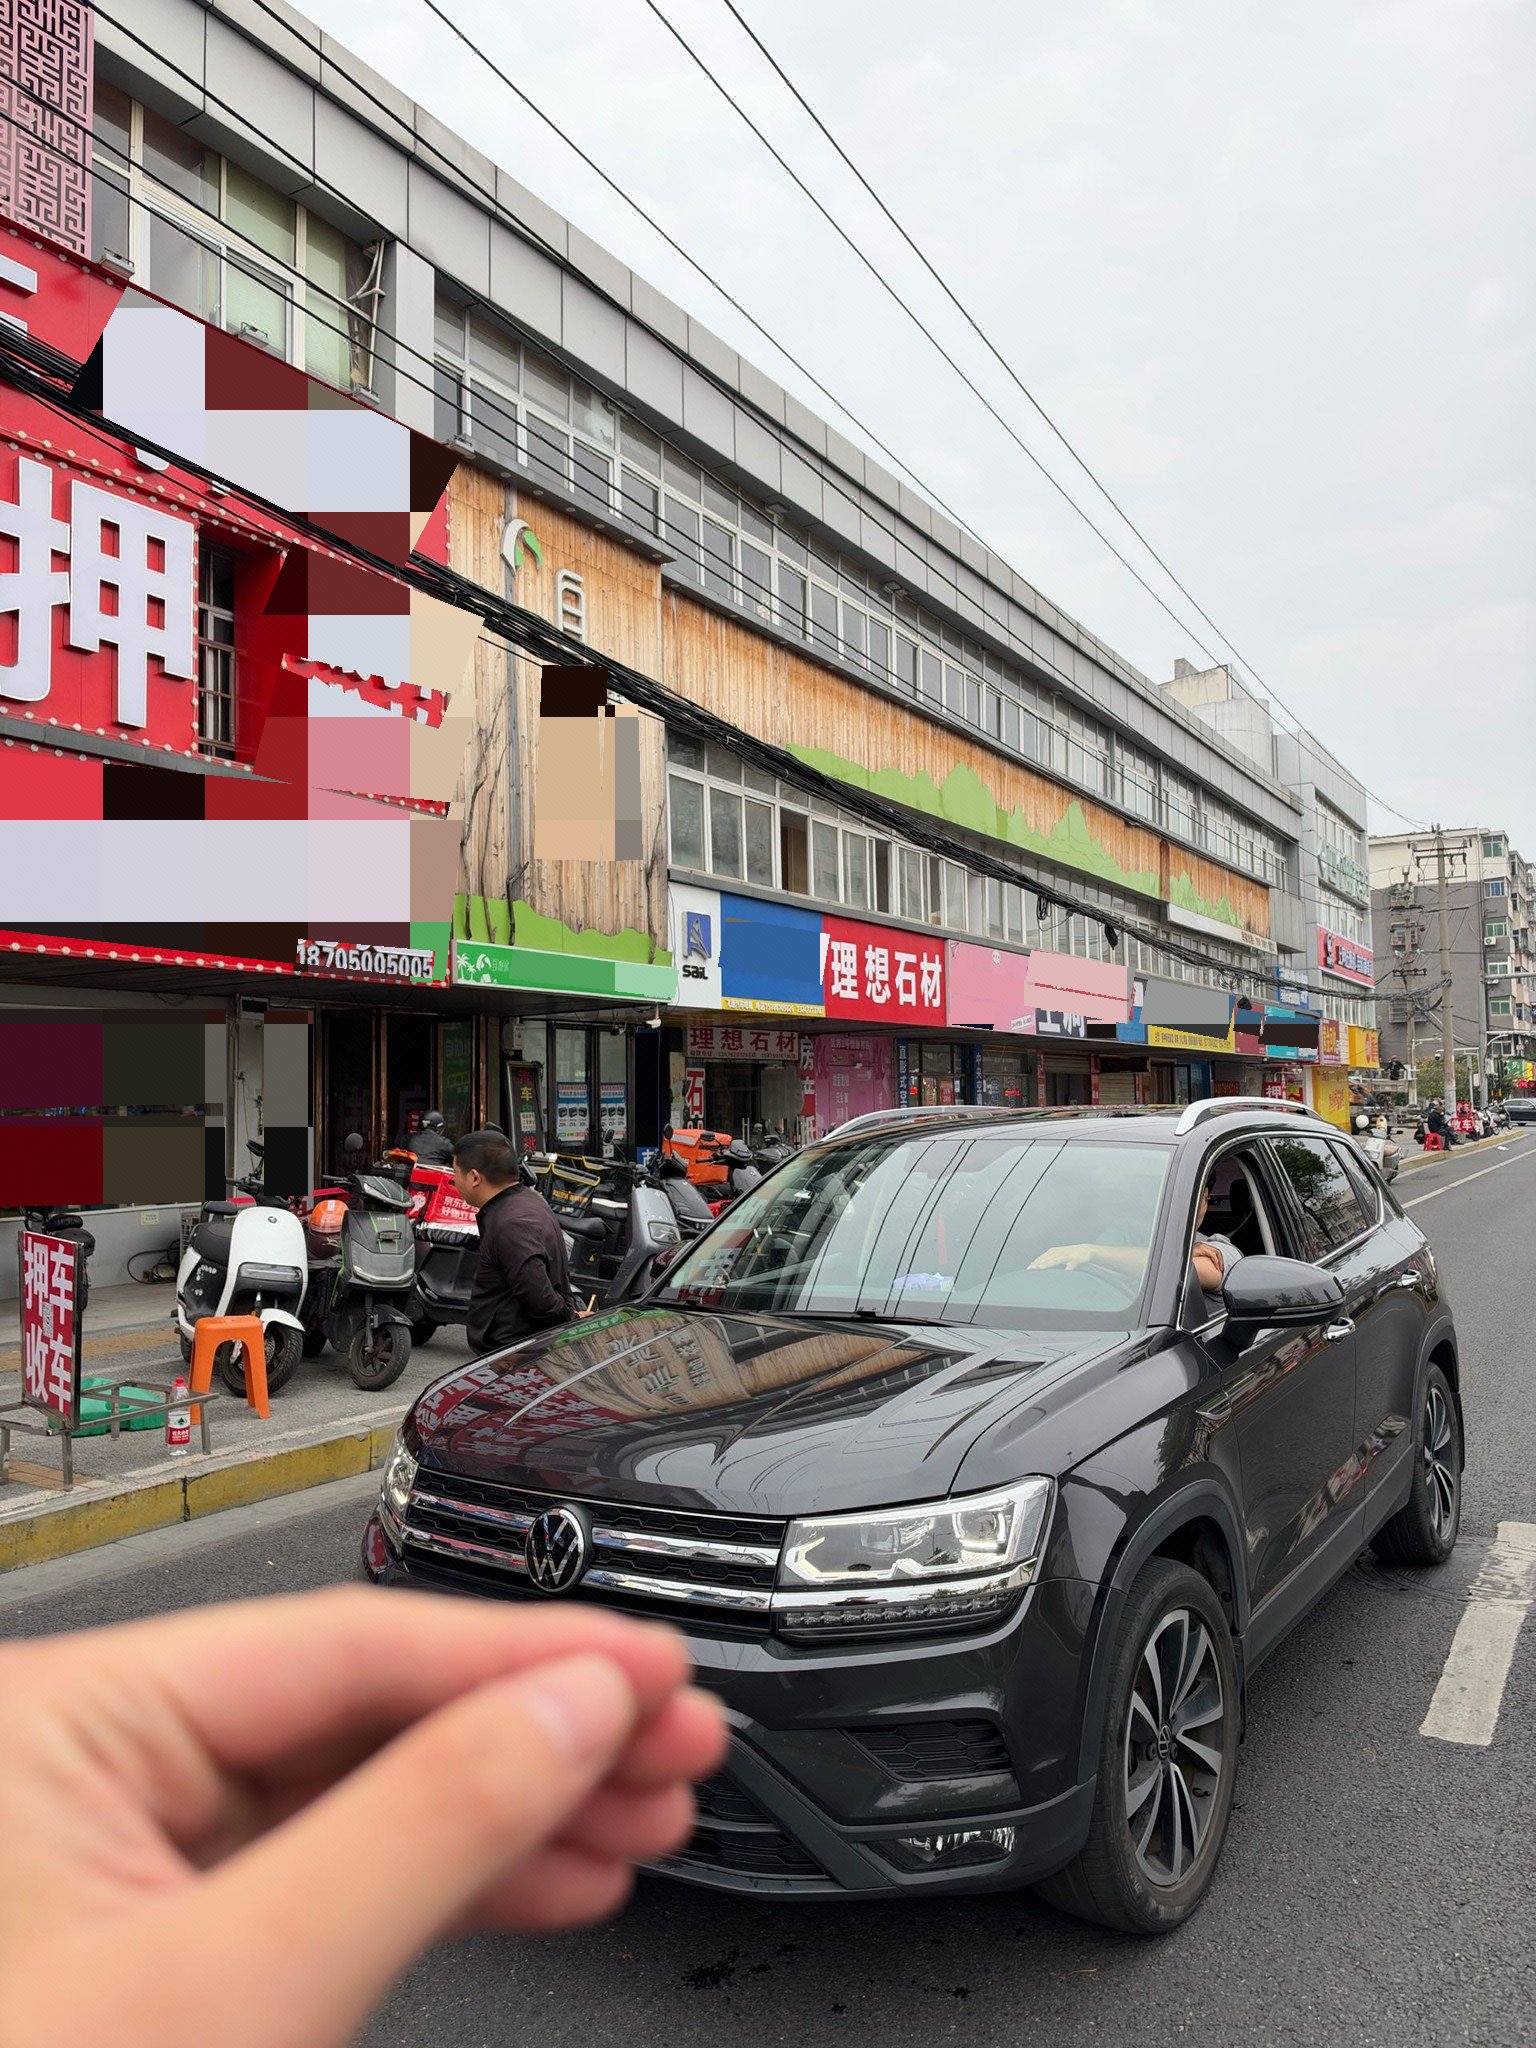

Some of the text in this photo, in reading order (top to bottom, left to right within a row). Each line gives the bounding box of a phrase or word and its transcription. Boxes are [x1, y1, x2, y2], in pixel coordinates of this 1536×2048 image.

[830, 941, 943, 1008] 理想石材
[689, 1027, 798, 1054] 理想石材
[24, 1236, 75, 1325] 押车
[25, 1322, 73, 1414] 收车
